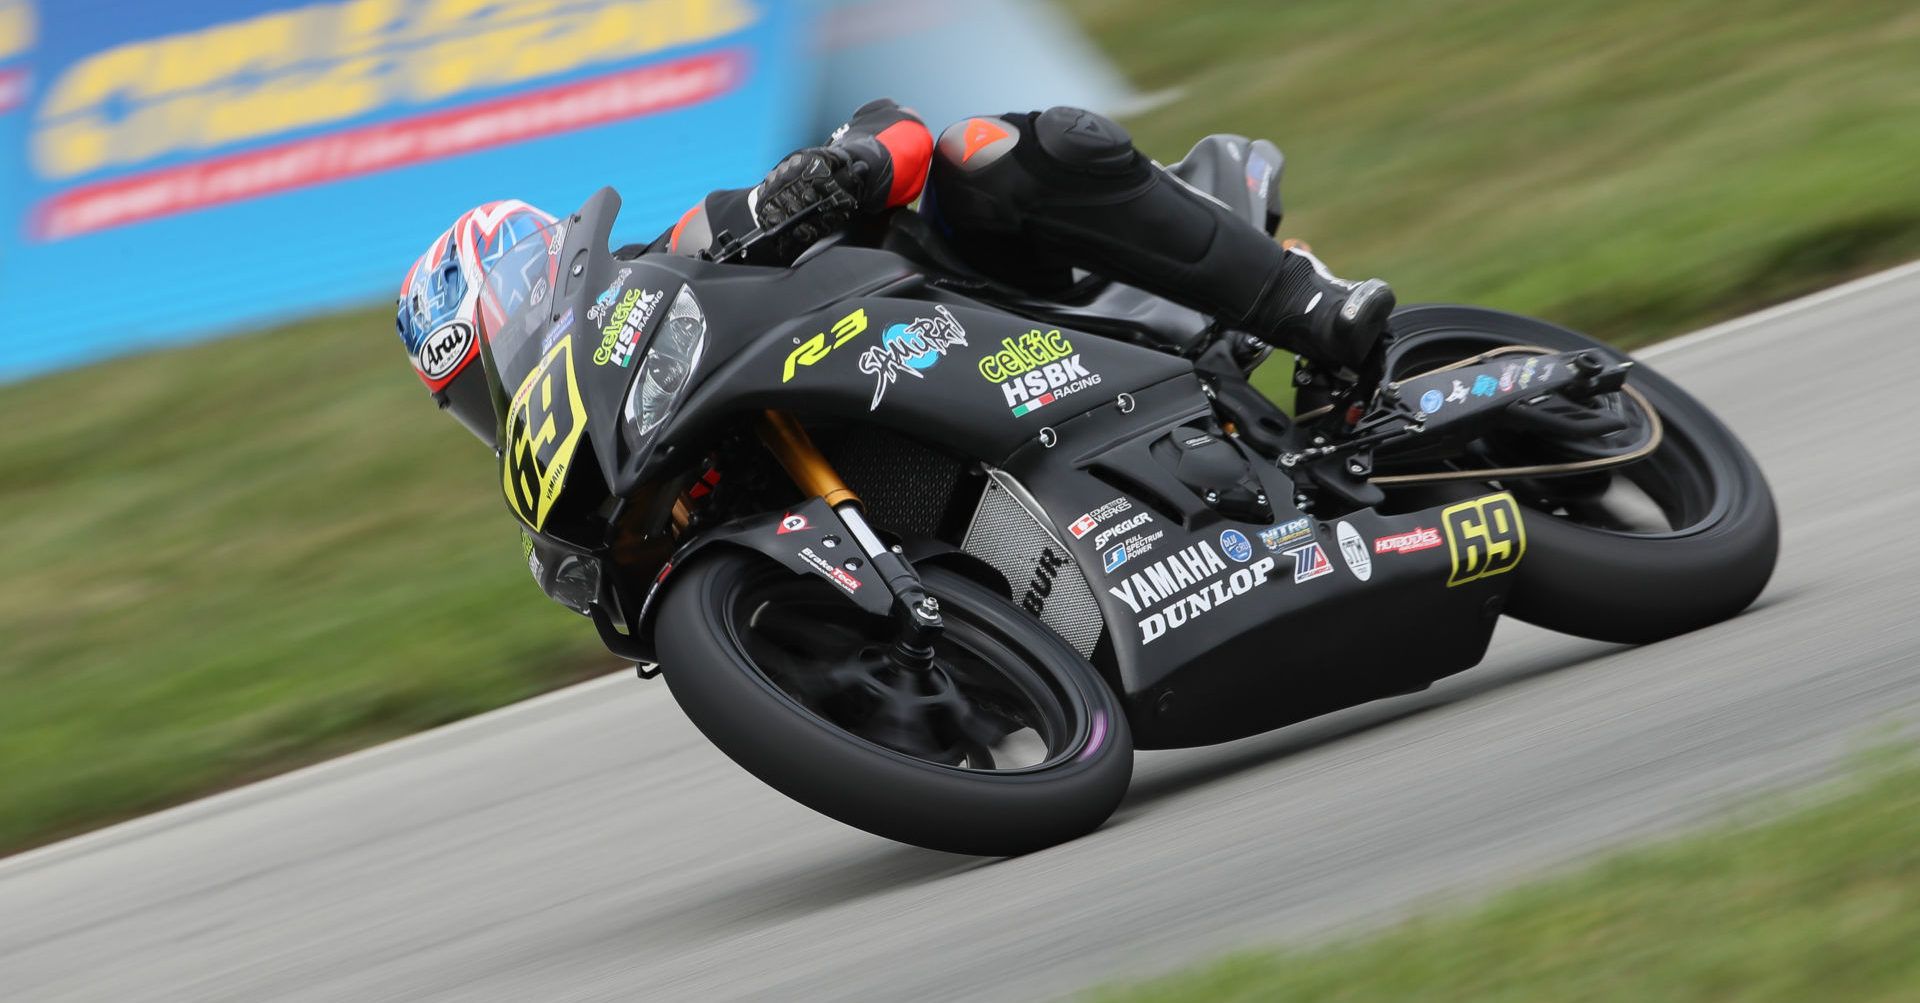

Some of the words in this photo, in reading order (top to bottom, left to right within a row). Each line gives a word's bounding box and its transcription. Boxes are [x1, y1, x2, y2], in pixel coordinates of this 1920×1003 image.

[610, 288, 656, 367] HSBK
[637, 290, 664, 332] RACING
[425, 324, 463, 374] Arai
[782, 308, 868, 383] R3
[858, 305, 969, 411] SAMURAI
[978, 329, 1074, 384] celtic
[1001, 353, 1091, 408] HSBK
[1053, 373, 1102, 401] RACING
[509, 345, 577, 524] 69
[546, 464, 565, 502] YAMAHA
[1094, 501, 1133, 523] WERKES
[1094, 512, 1154, 551] SPIEGLER
[1260, 518, 1309, 542] NITRO
[1125, 534, 1143, 546] FULL
[1126, 530, 1164, 553] SPECTRUM
[1127, 543, 1153, 560] POWER
[1445, 497, 1521, 583] 69
[1109, 540, 1228, 614] YAMAHA
[1138, 556, 1275, 645] DUNLOP
